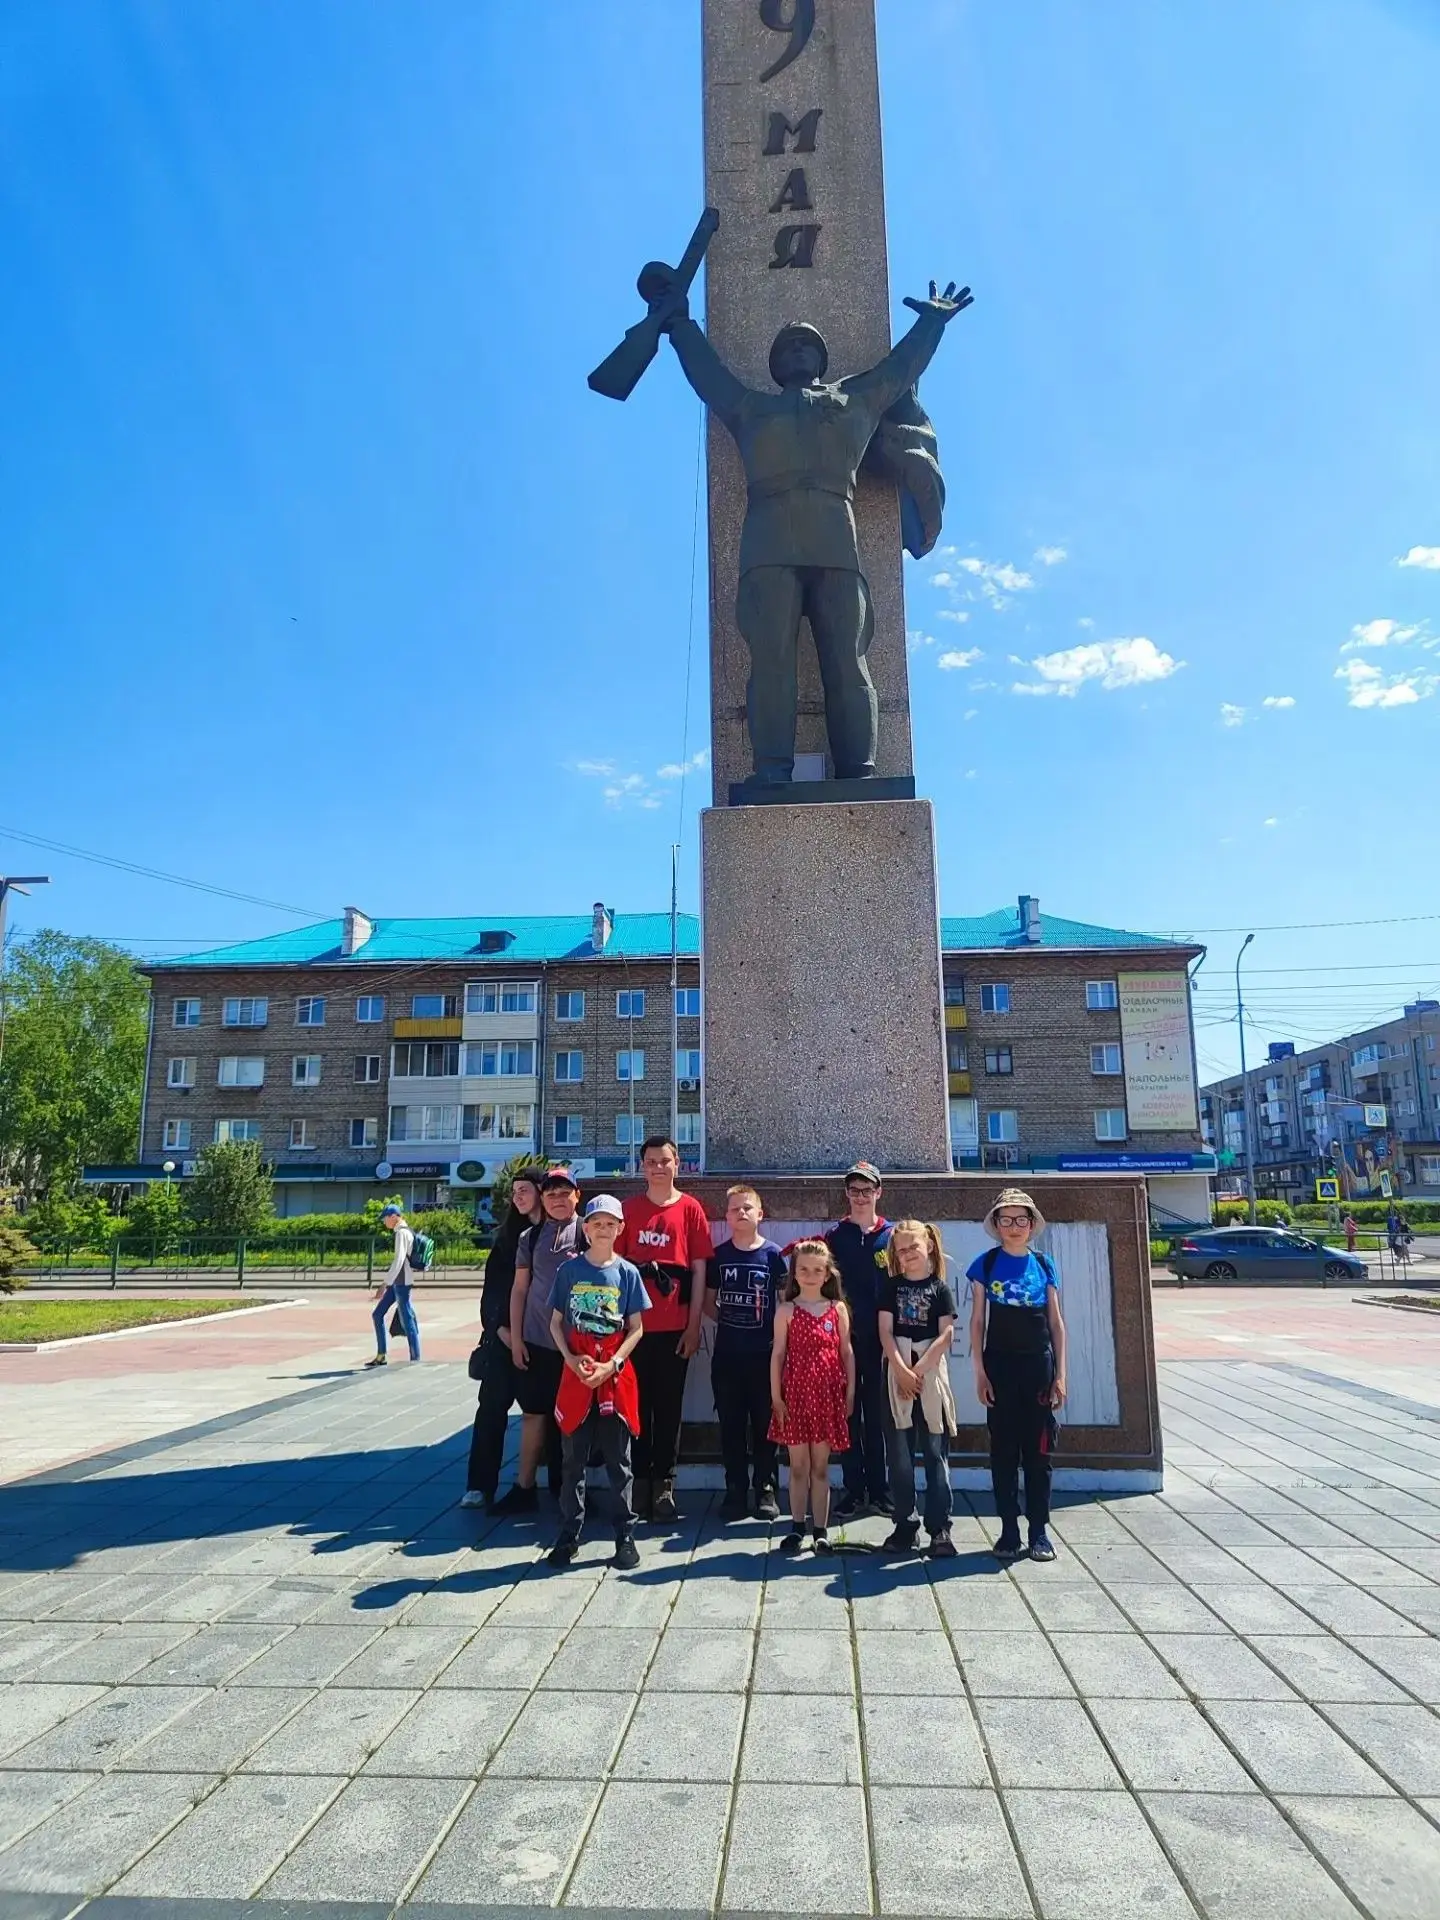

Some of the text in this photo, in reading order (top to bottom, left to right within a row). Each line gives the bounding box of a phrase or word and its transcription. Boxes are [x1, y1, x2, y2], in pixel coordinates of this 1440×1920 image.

[760, 0, 815, 83] 9
[1122, 997, 1184, 1006] ОТДЕЛОЧНЫЕ
[1128, 1074, 1190, 1083] НАПОЛЬНЫЕ
